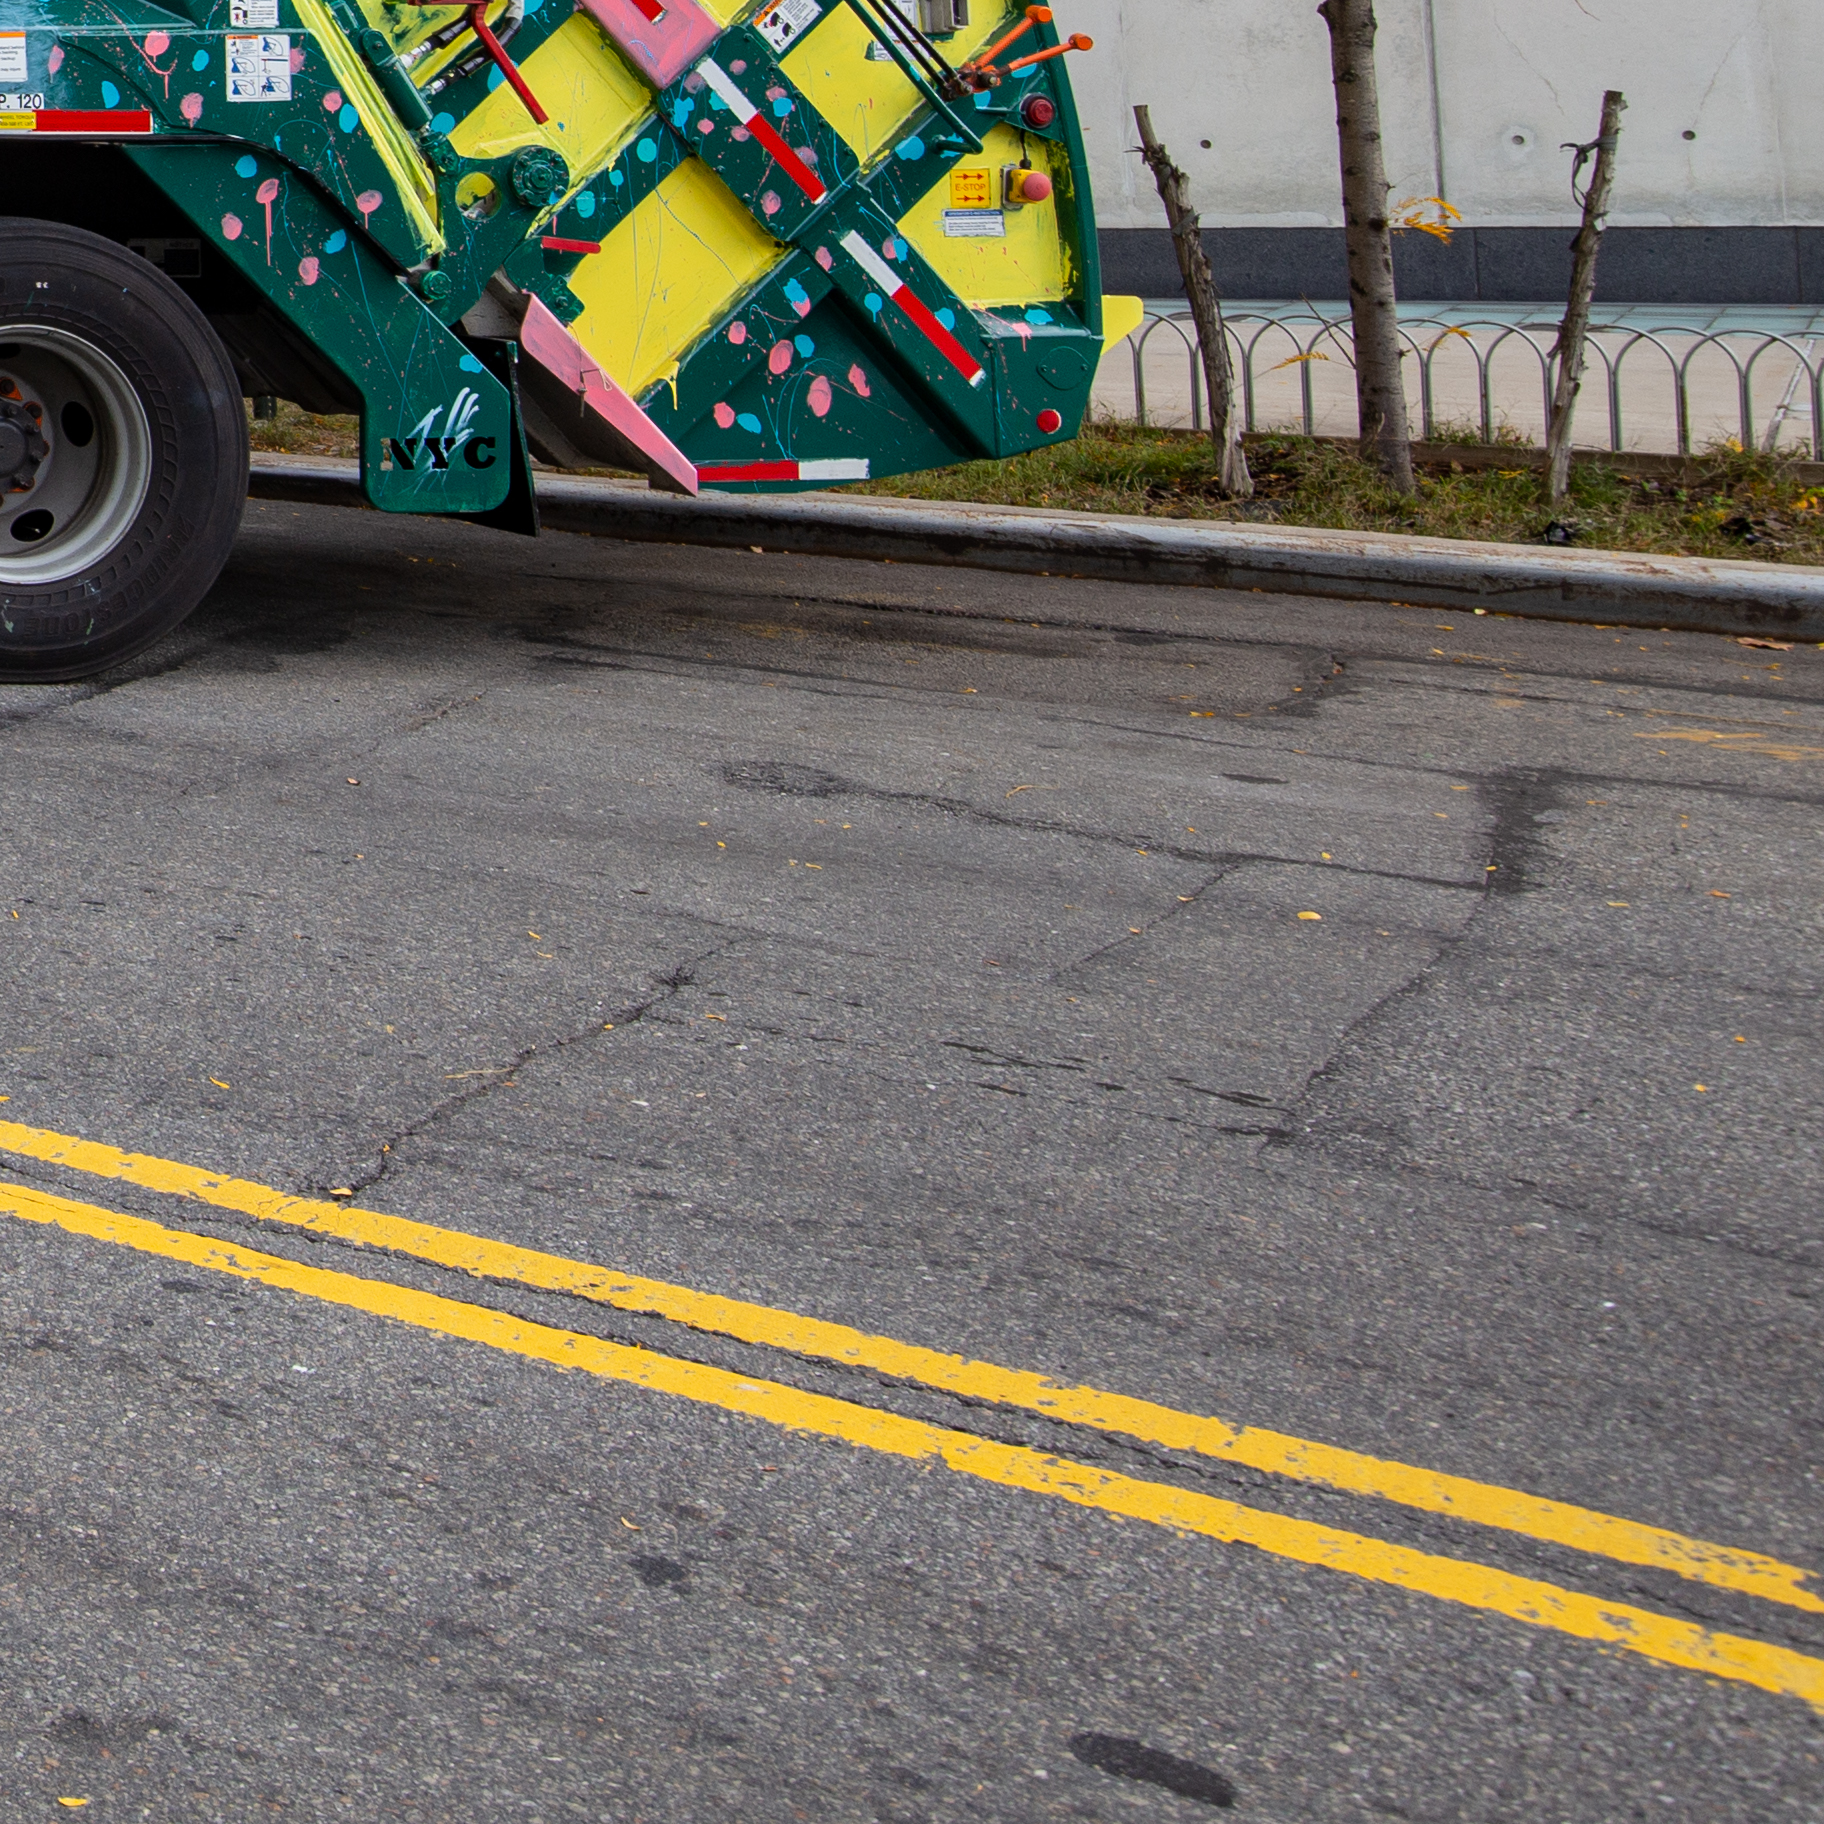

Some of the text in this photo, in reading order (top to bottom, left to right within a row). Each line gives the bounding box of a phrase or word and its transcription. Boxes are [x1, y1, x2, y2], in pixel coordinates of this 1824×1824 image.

[17, 93, 43, 109] 120
[955, 183, 986, 191] E-STOP
[380, 436, 497, 471] NYC
